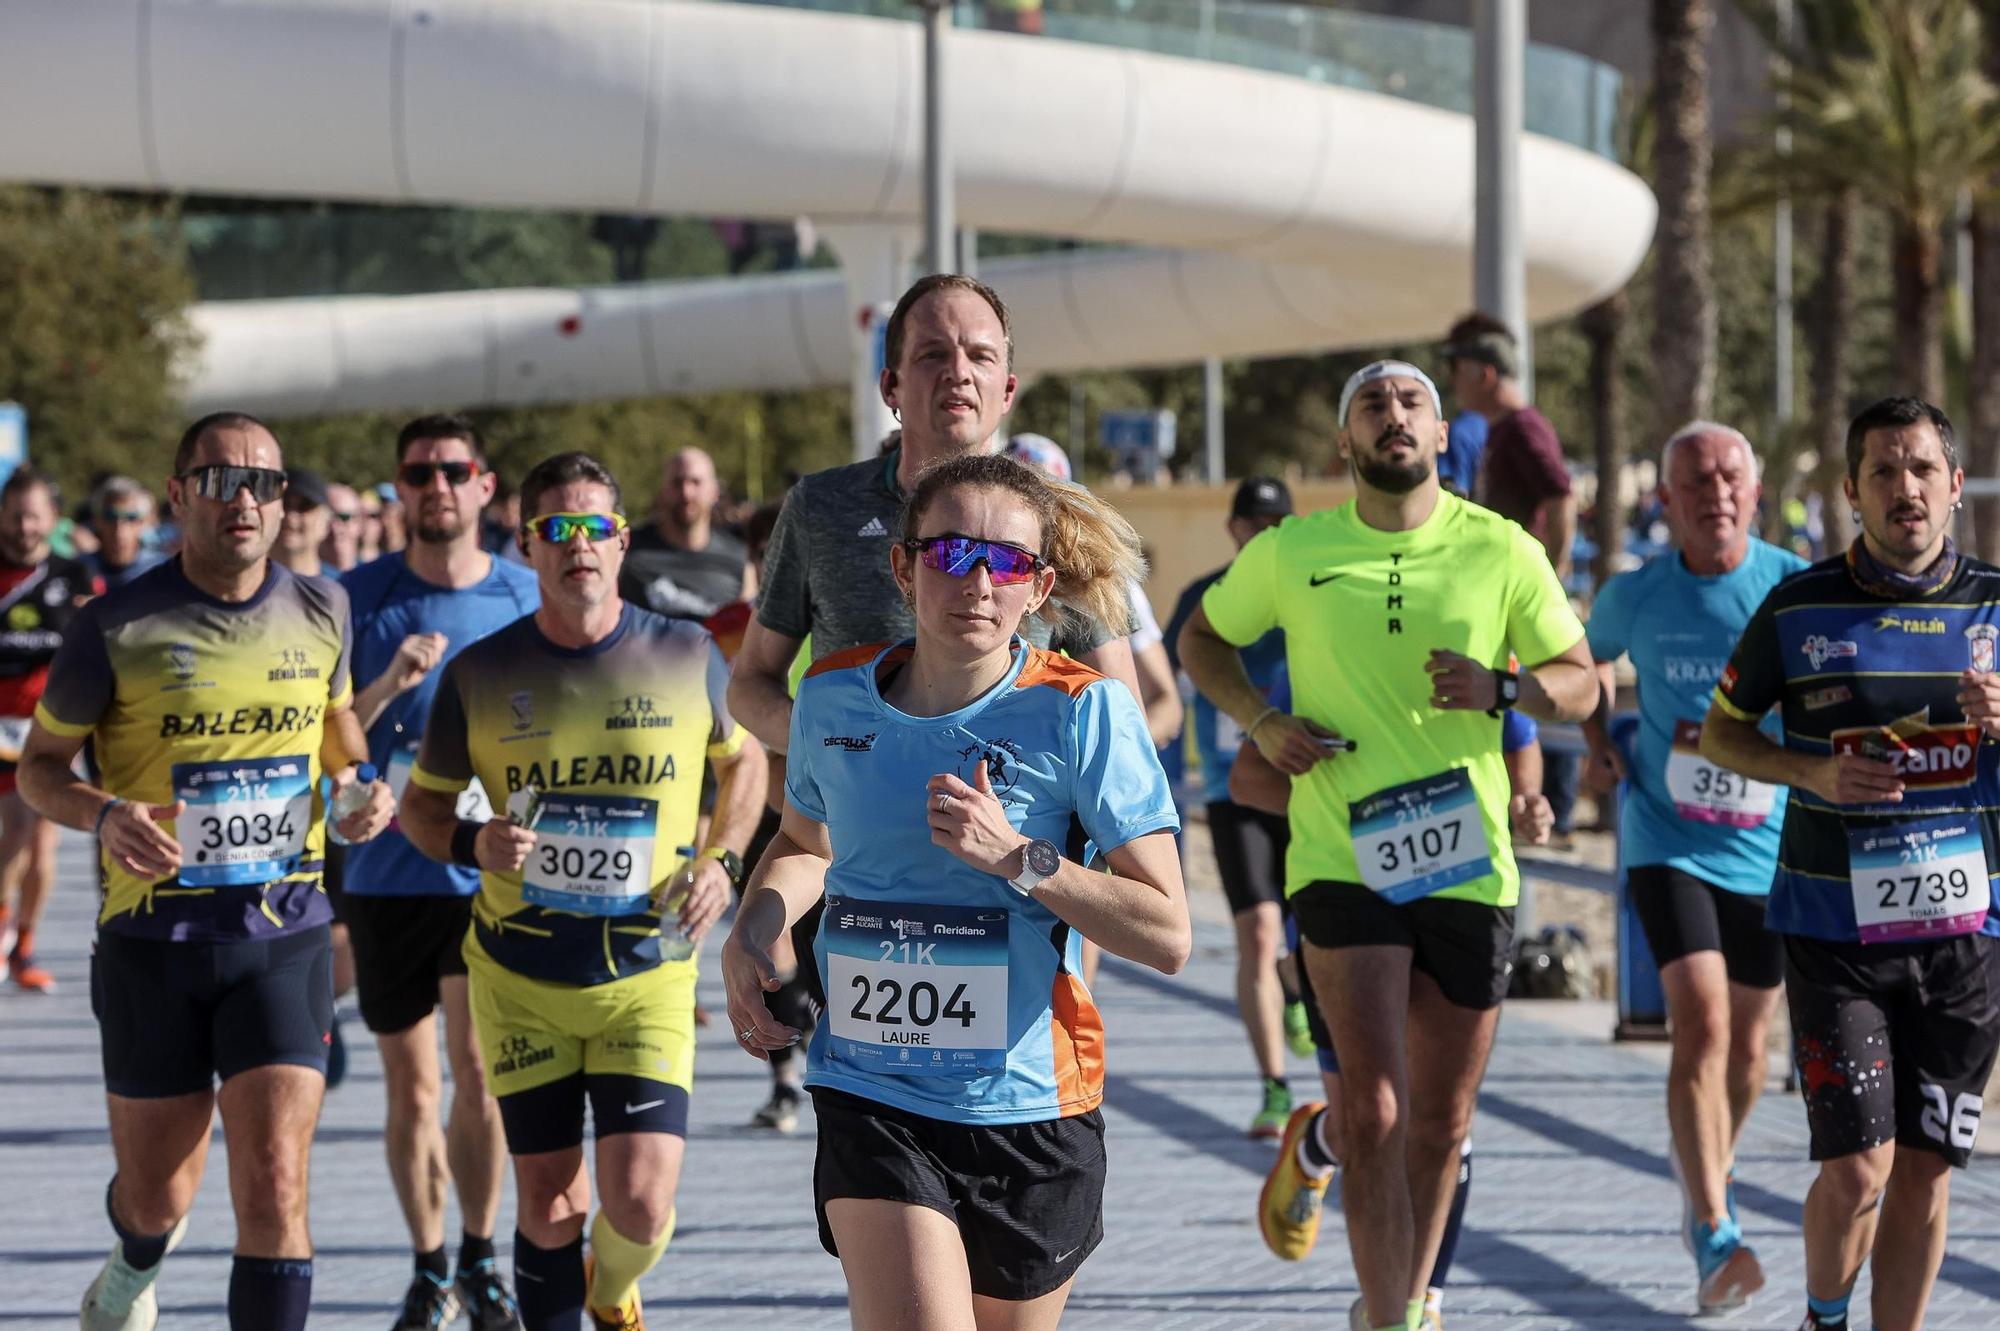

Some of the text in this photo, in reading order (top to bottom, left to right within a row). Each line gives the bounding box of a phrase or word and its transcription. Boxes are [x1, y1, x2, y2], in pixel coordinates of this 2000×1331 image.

[506, 754, 676, 792] BALEARIA
[226, 783, 270, 801] 21K
[1395, 802, 1434, 822] 21K
[201, 810, 294, 849] 3034
[566, 819, 609, 837] 21K
[1377, 818, 1462, 872] 3107
[1900, 843, 1938, 863] 21K
[540, 844, 632, 881] 3029
[1876, 868, 1969, 908] 2739
[856, 915, 875, 923] AGUAS
[933, 924, 986, 936] Meridiano
[879, 940, 937, 966] 21K
[850, 974, 976, 1028] 2204
[881, 1030, 930, 1045] LAURE
[1920, 1083, 1984, 1150] 26
